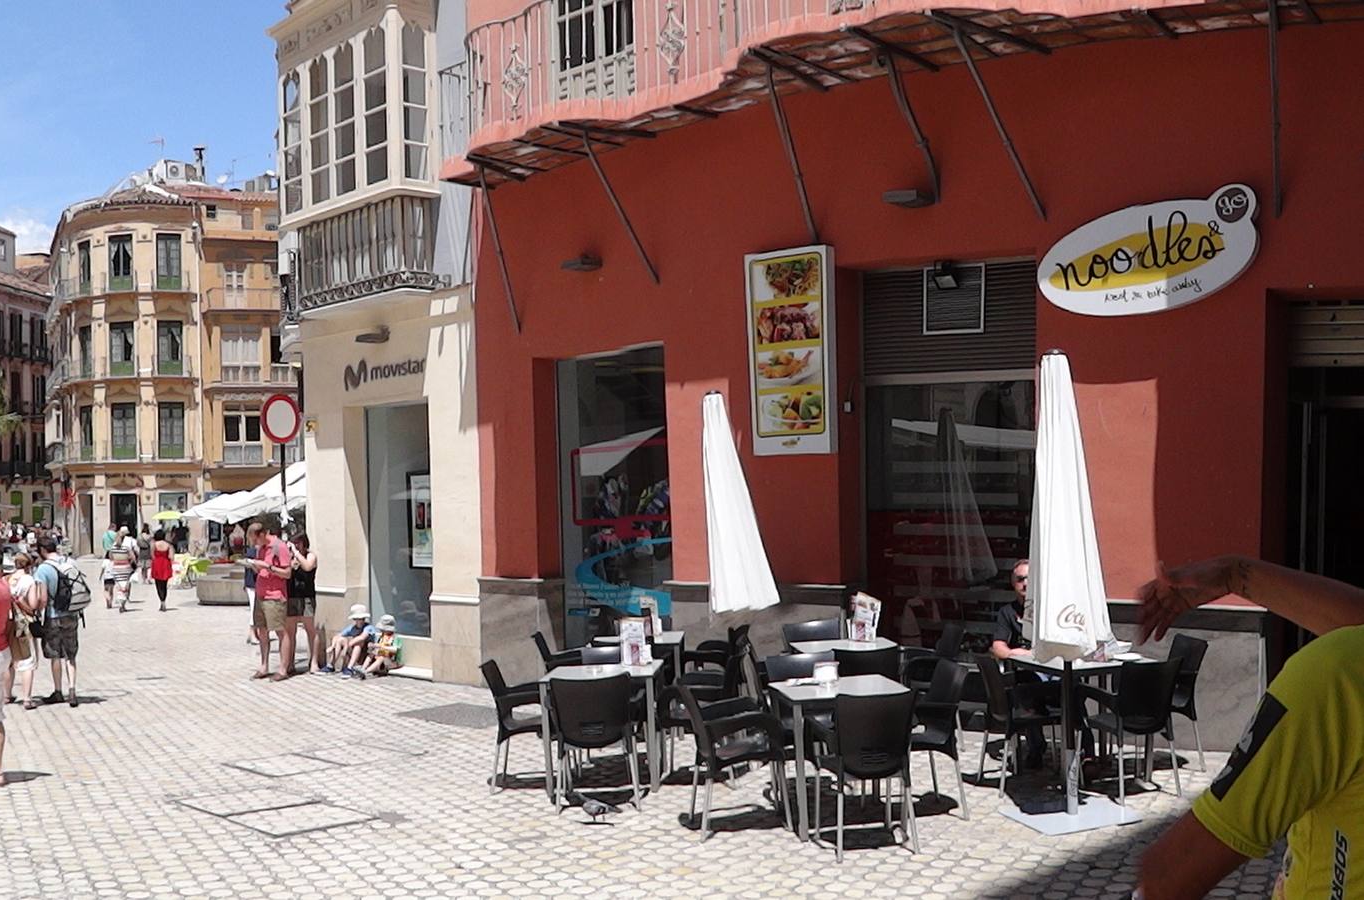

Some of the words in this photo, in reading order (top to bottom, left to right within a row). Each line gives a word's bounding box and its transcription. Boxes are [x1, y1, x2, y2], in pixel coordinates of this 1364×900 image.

[1217, 193, 1249, 216] go
[1055, 209, 1225, 291] noodles
[371, 359, 425, 380] movistar
